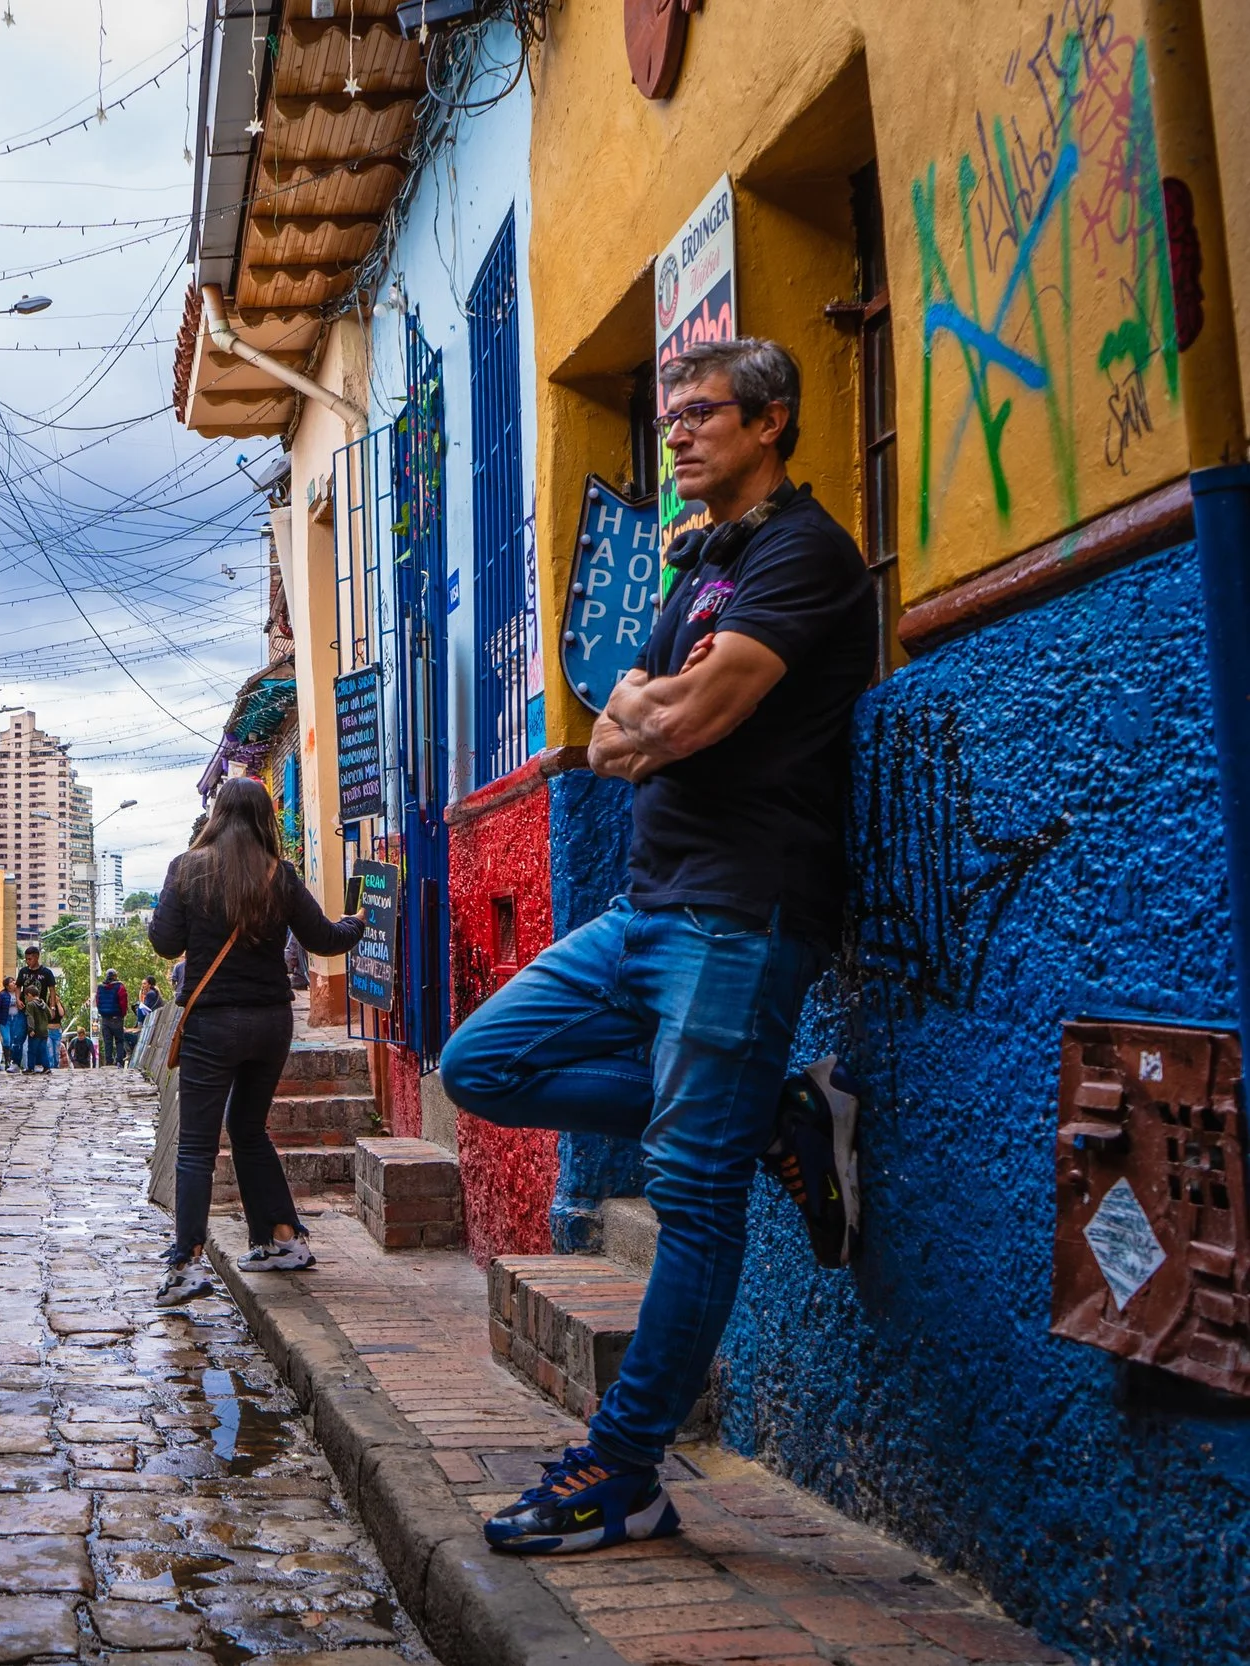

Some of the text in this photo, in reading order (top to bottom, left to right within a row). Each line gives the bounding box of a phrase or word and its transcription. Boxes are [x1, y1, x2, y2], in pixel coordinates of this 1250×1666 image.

[682, 191, 730, 269] ERDINGER
[579, 504, 623, 661] HAPPY
[616, 520, 659, 647] HOUR
[365, 874, 386, 890] GRAN
[369, 909, 376, 924] 2
[358, 940, 389, 961] CHICHA
